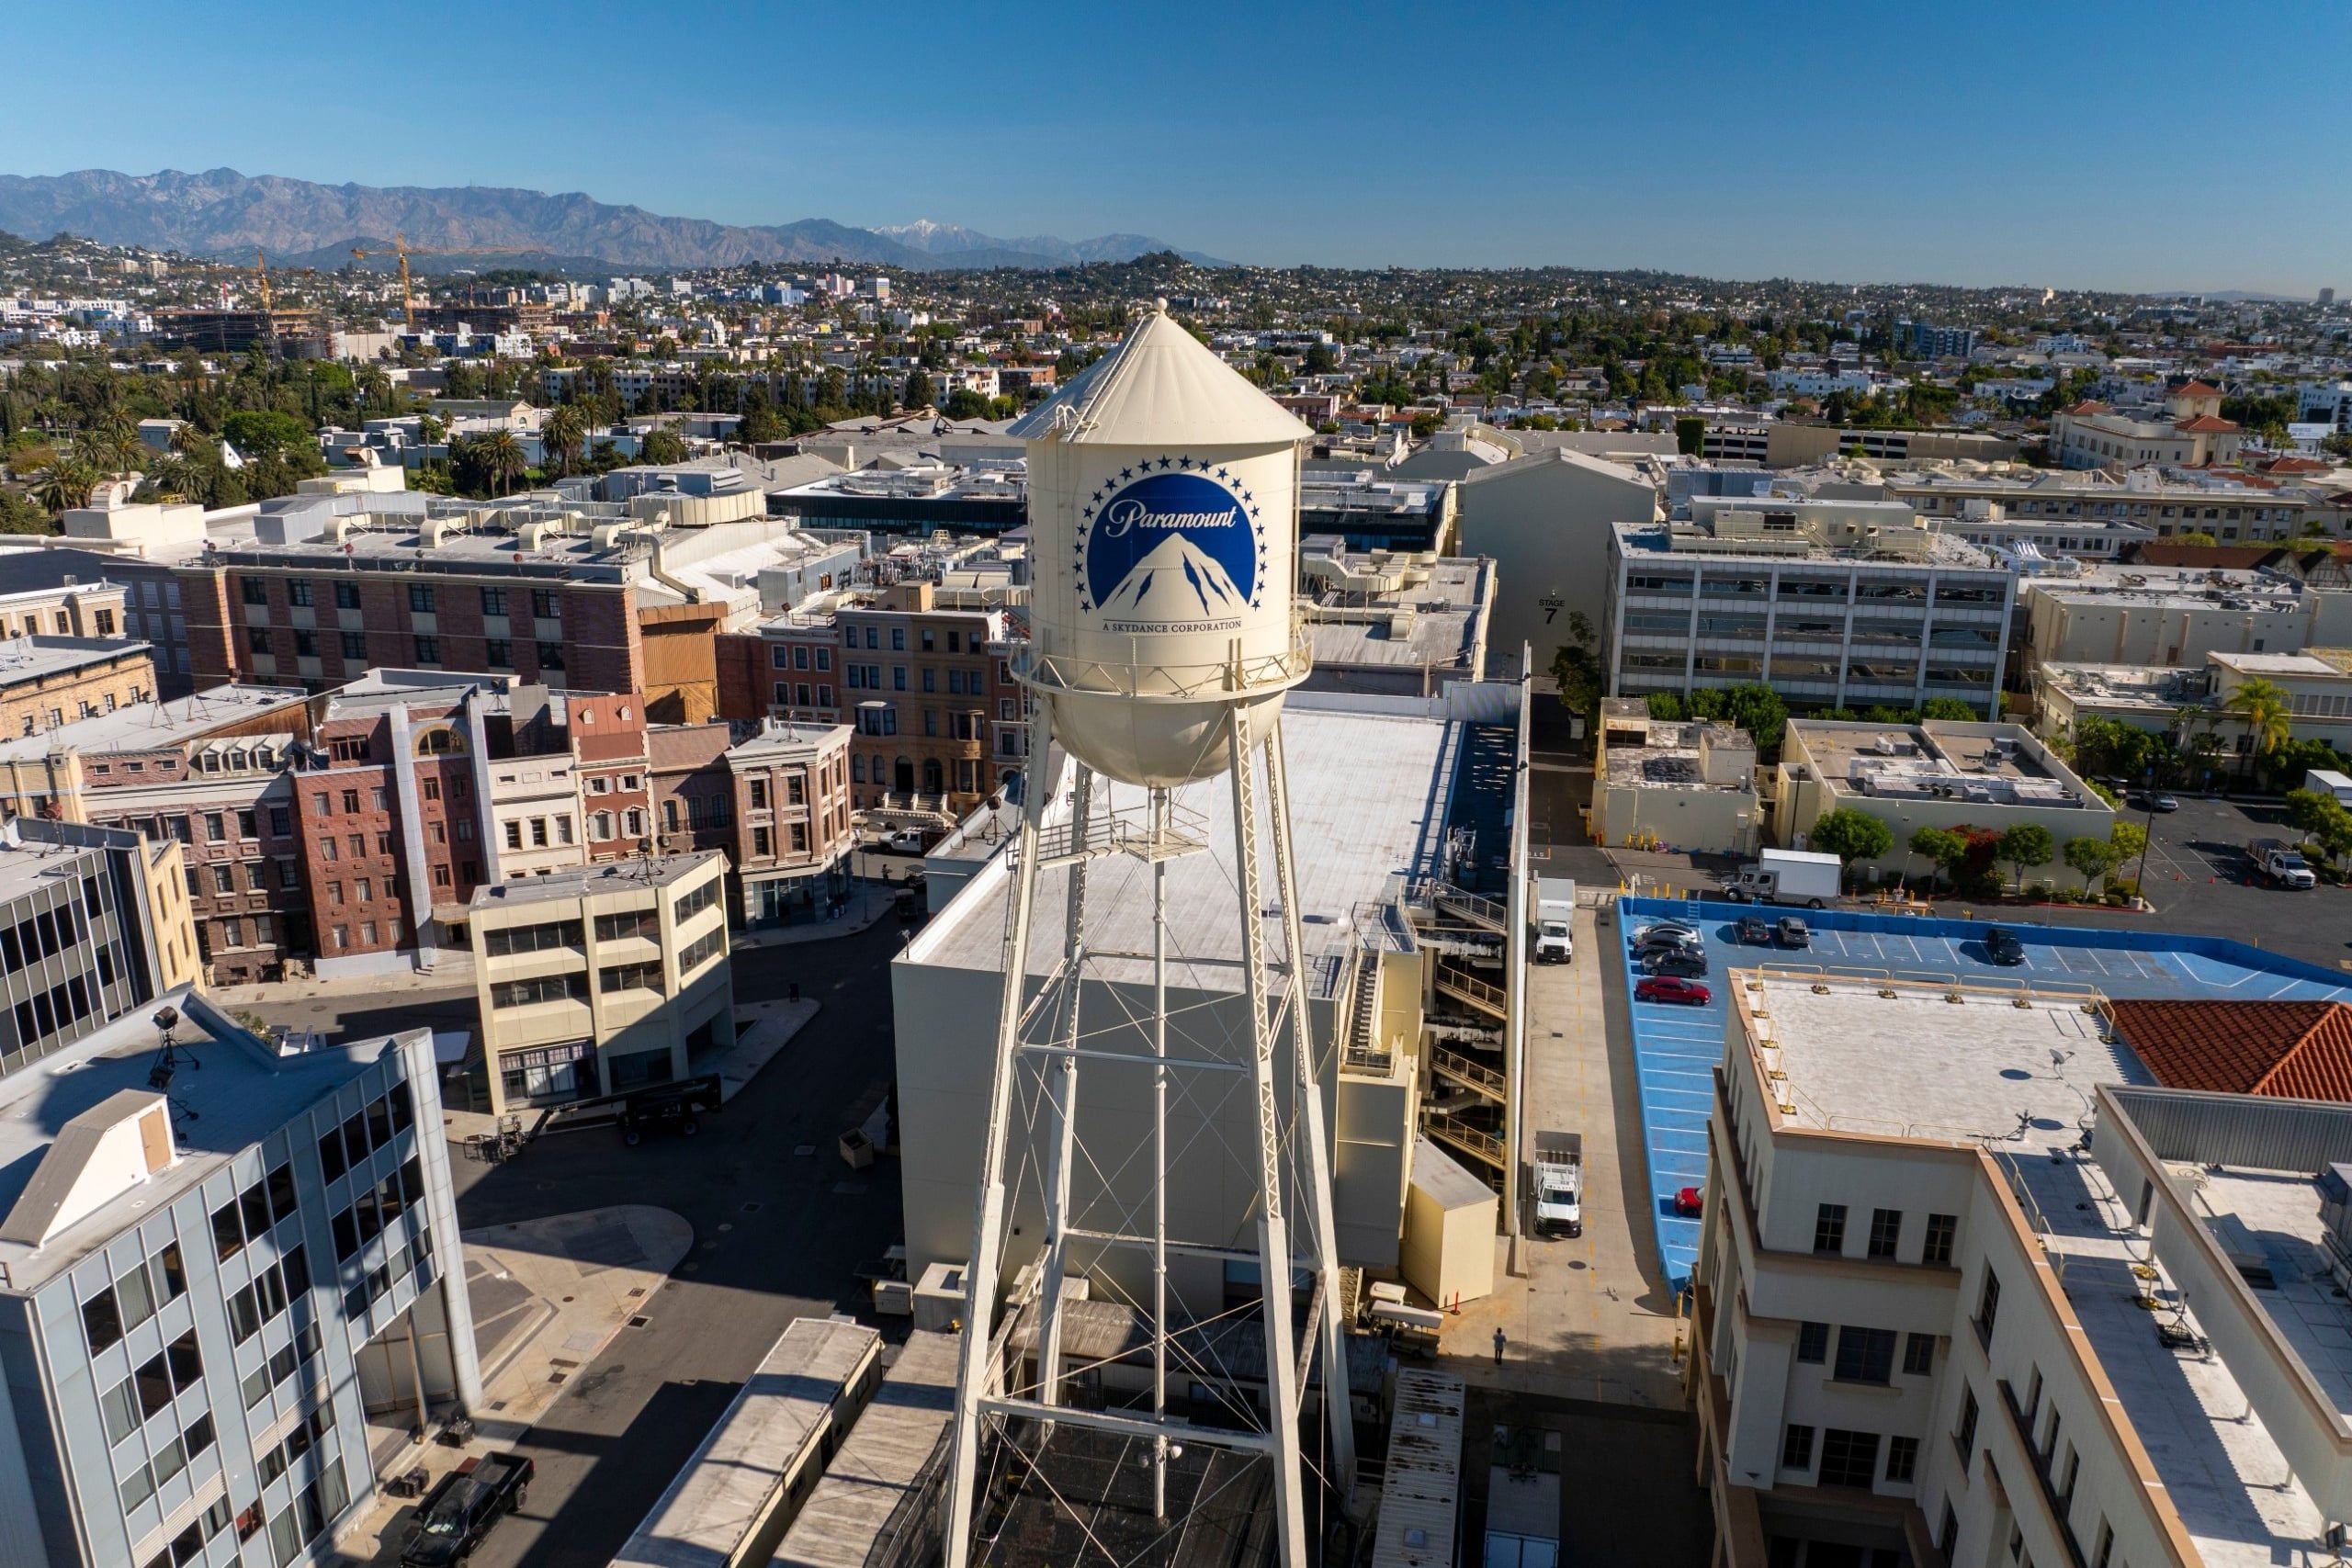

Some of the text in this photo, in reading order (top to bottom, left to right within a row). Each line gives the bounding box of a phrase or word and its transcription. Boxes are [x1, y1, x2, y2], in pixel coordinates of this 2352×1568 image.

[1105, 499, 1237, 537] Paramount
[1539, 598, 1566, 607] STAGE
[1544, 608, 1558, 625] 7
[1102, 620, 1241, 633] A SKYDANCE CORPORATION
